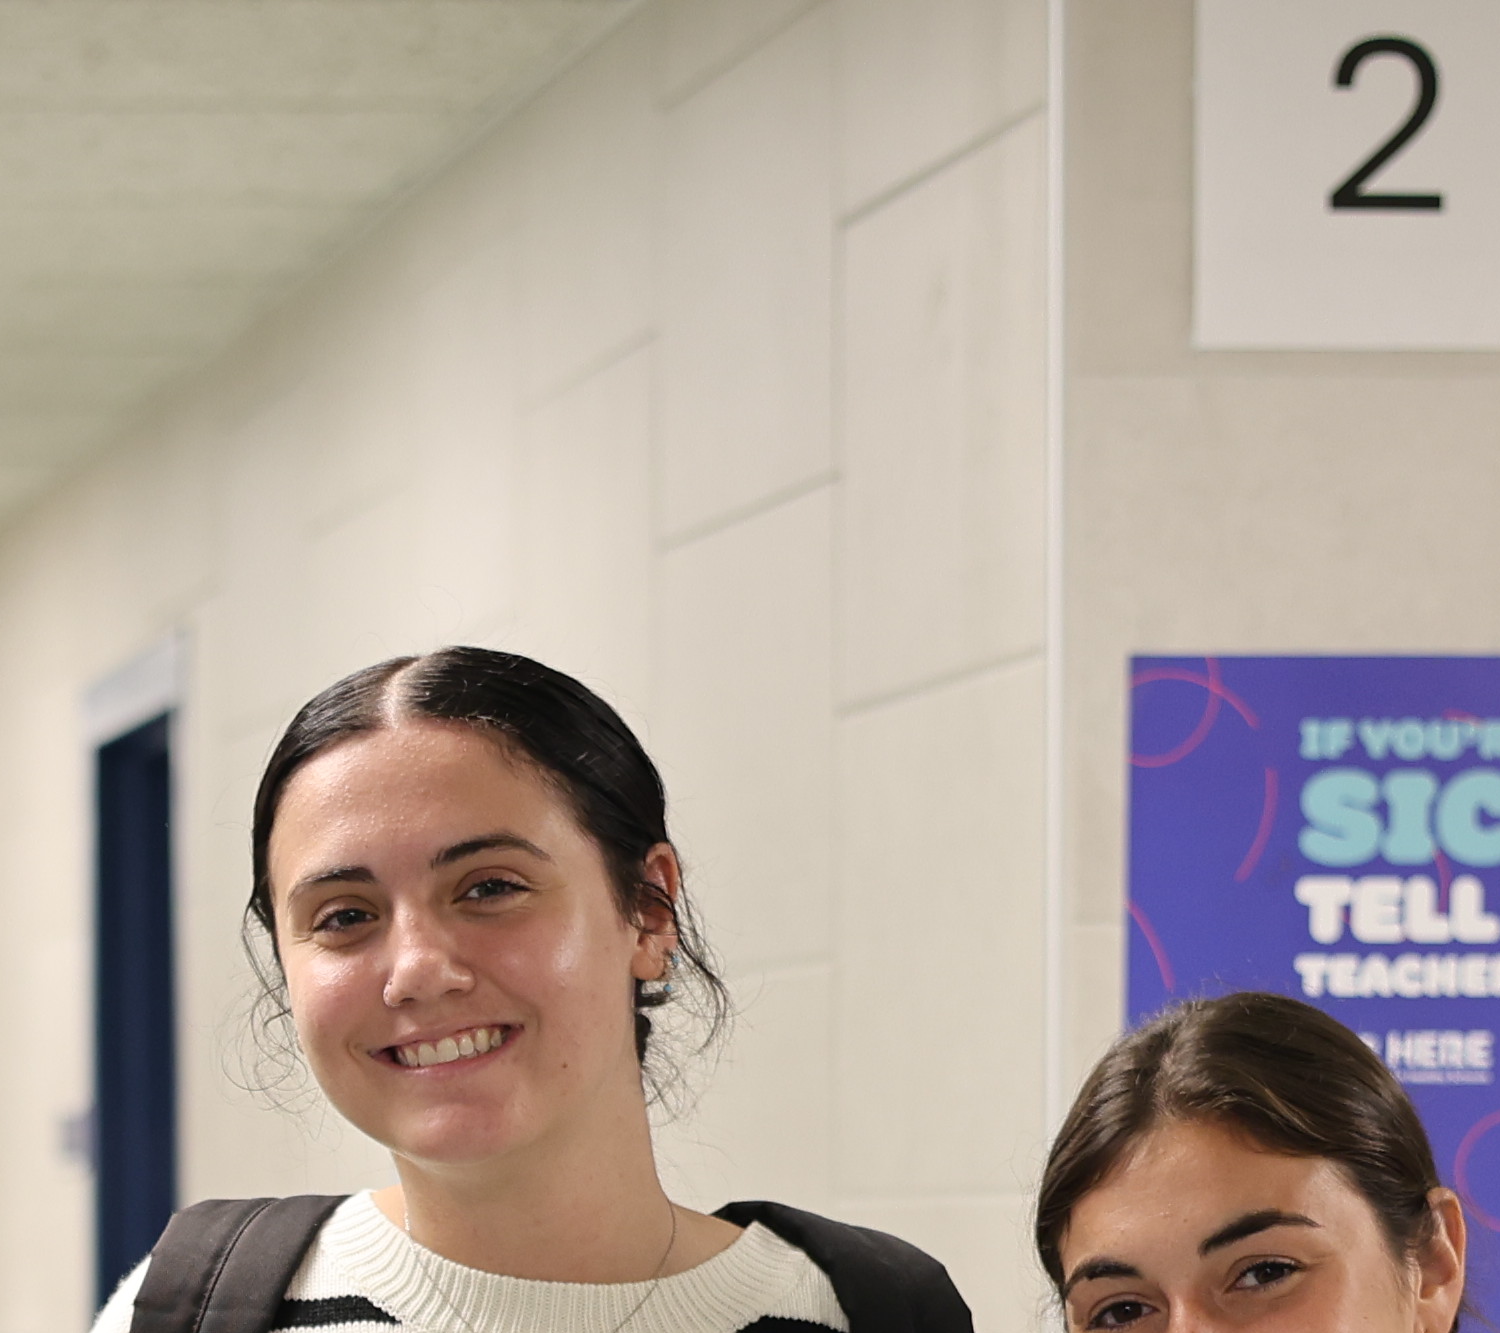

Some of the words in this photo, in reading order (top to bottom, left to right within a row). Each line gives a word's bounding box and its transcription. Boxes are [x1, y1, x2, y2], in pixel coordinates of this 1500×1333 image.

[1332, 37, 1441, 207] 2
[1299, 717, 1353, 760] IF
[1386, 1030, 1494, 1068] HERE
